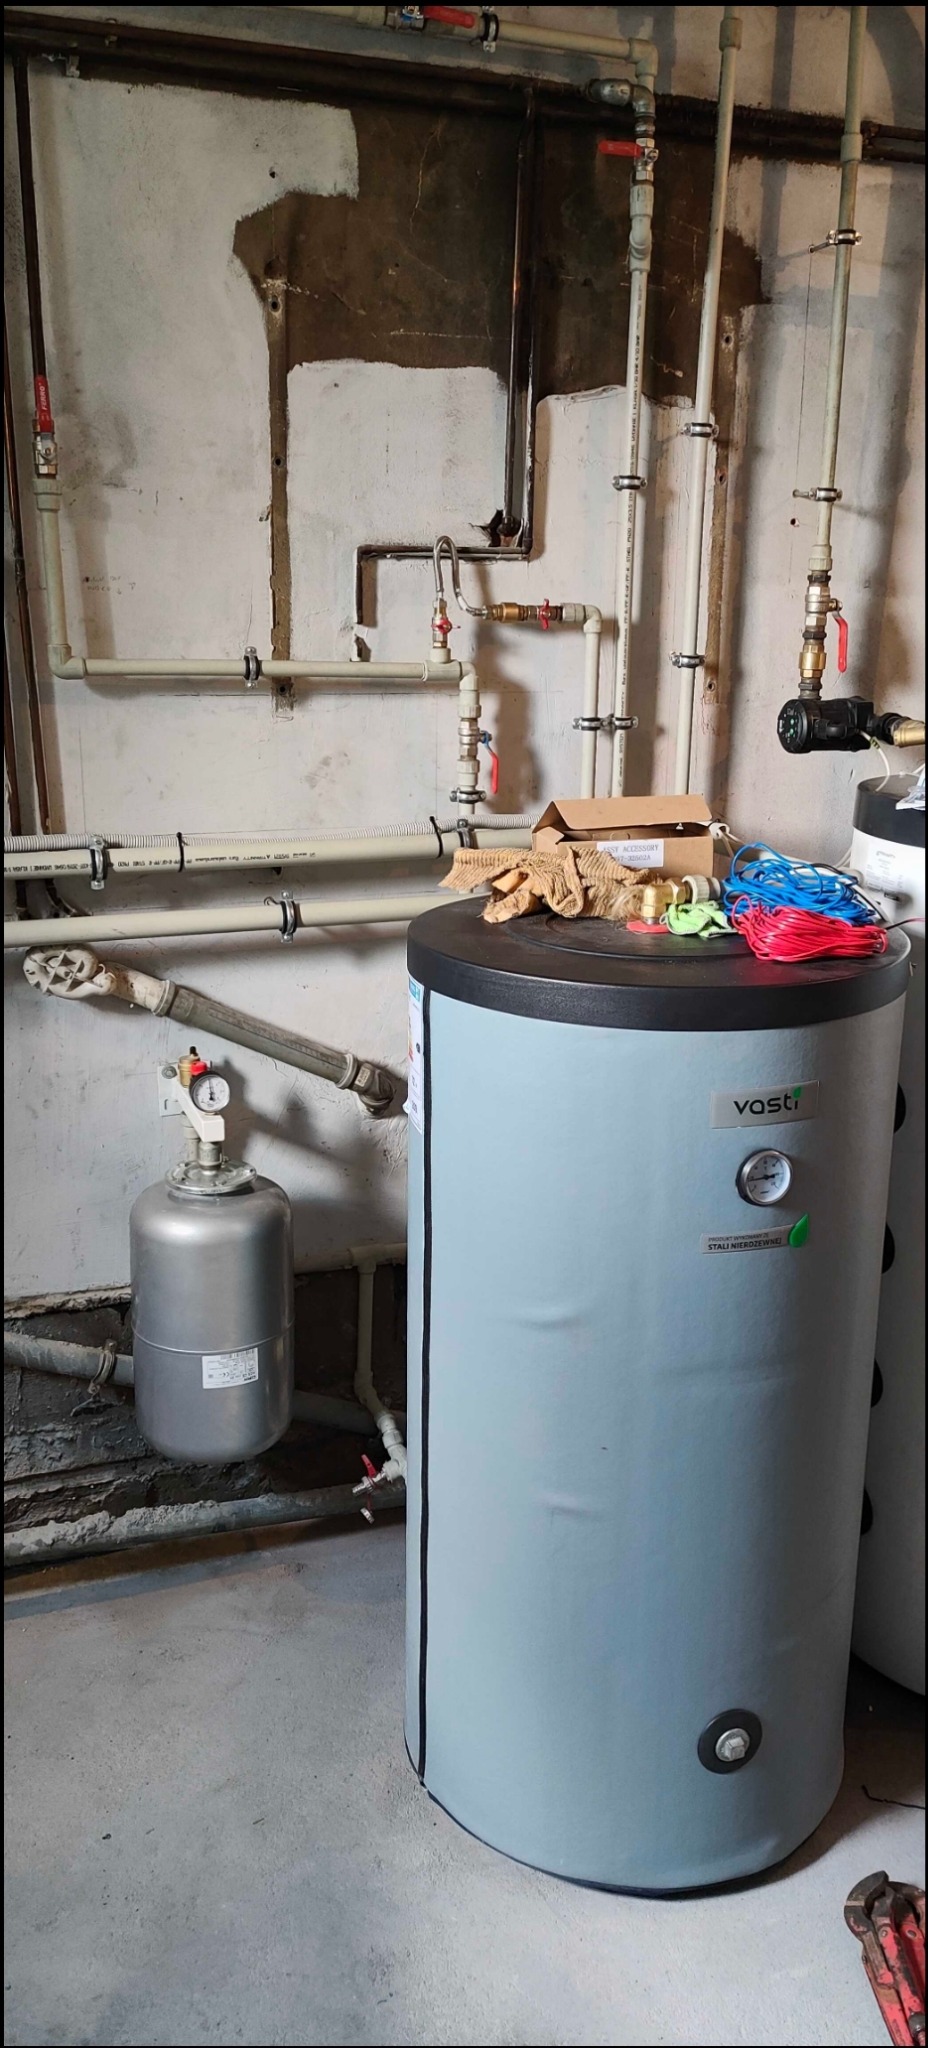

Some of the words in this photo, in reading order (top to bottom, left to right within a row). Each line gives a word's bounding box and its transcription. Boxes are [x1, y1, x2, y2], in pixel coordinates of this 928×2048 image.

[623, 844, 659, 852] ACCESSORY
[733, 1086, 801, 1116] vasti
[707, 1243, 729, 1251] STALI
[730, 1237, 782, 1250] NIERDZEWNEJ
